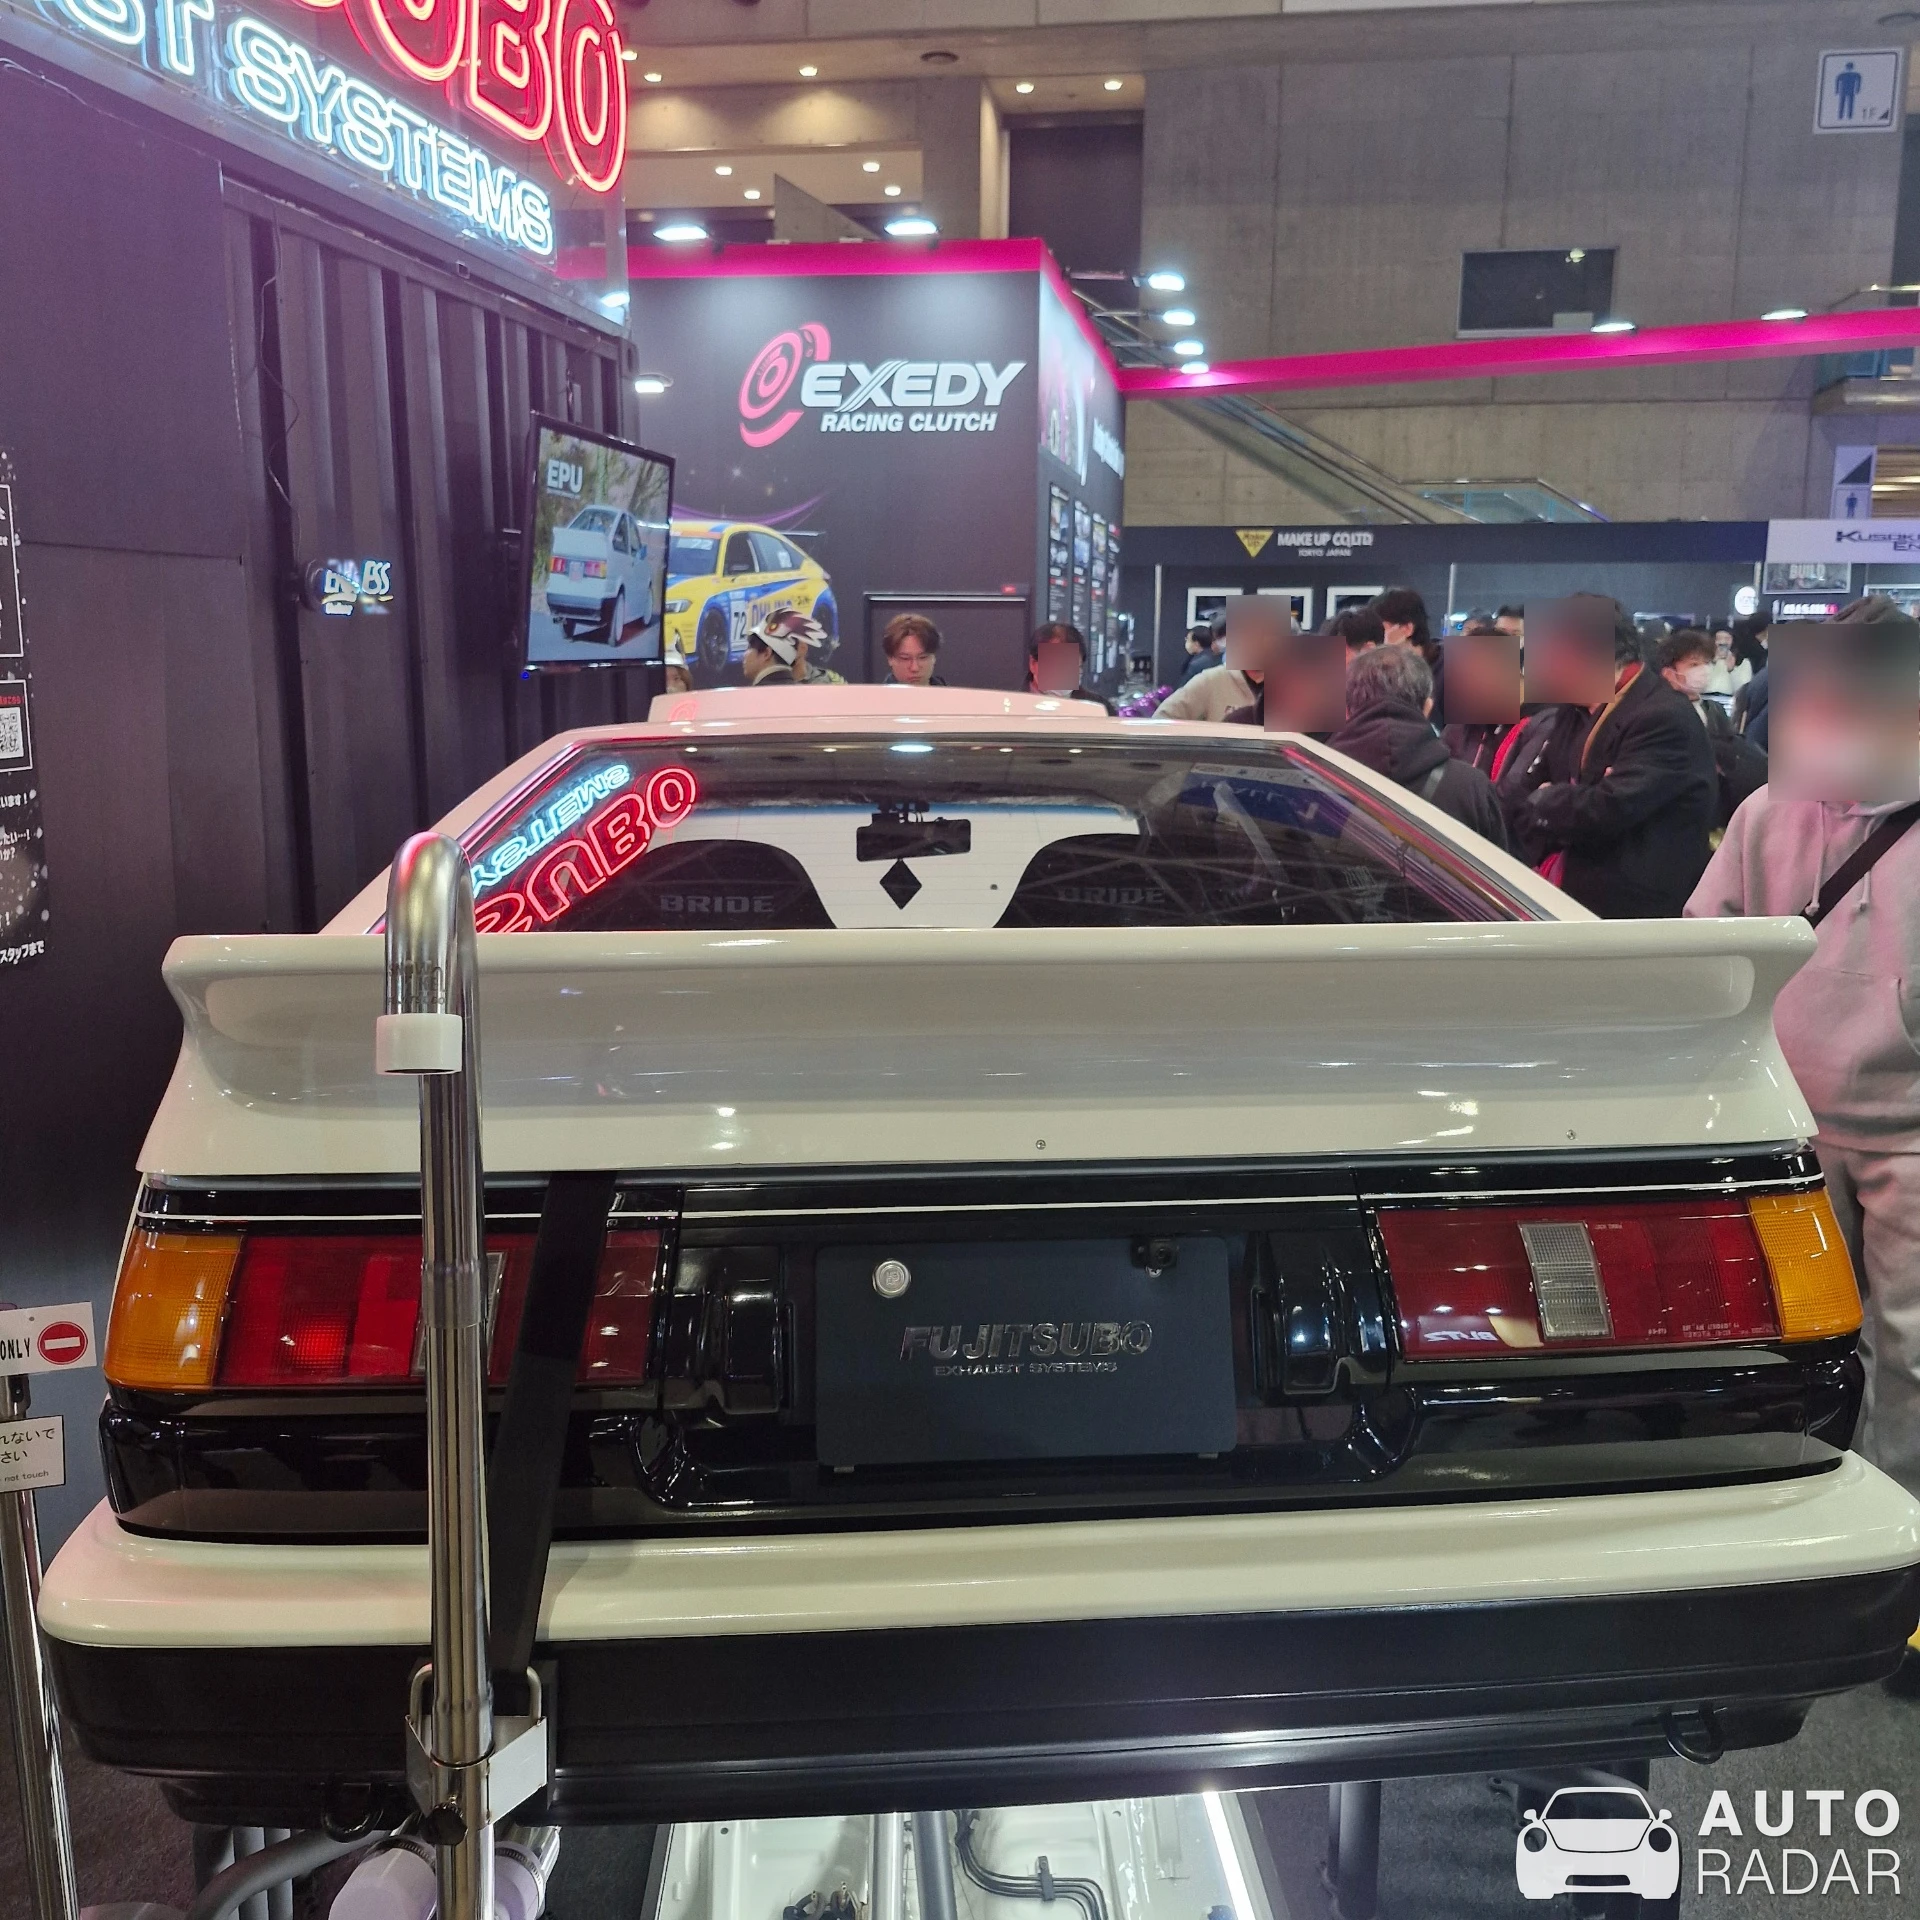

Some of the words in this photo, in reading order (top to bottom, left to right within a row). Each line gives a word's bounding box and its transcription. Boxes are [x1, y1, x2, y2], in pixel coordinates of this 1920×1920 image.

[225, 15, 556, 256] SYSTEMS
[800, 359, 1027, 412] EXEDY
[820, 412, 903, 432] RACING
[908, 412, 998, 432] CLUTCH
[547, 459, 583, 494] EPU
[1277, 532, 1313, 546] MAKE
[1314, 533, 1331, 546] UP
[733, 611, 748, 640] 72
[660, 895, 774, 913] BRIDE
[0, 1337, 30, 1361] ONLY
[901, 1320, 1153, 1361] FUJITSUBO
[934, 1364, 1024, 1376] EXHAUST
[1029, 1361, 1118, 1373] SYSTEMS
[4, 1474, 19, 1482] not
[22, 1470, 49, 1479] touch
